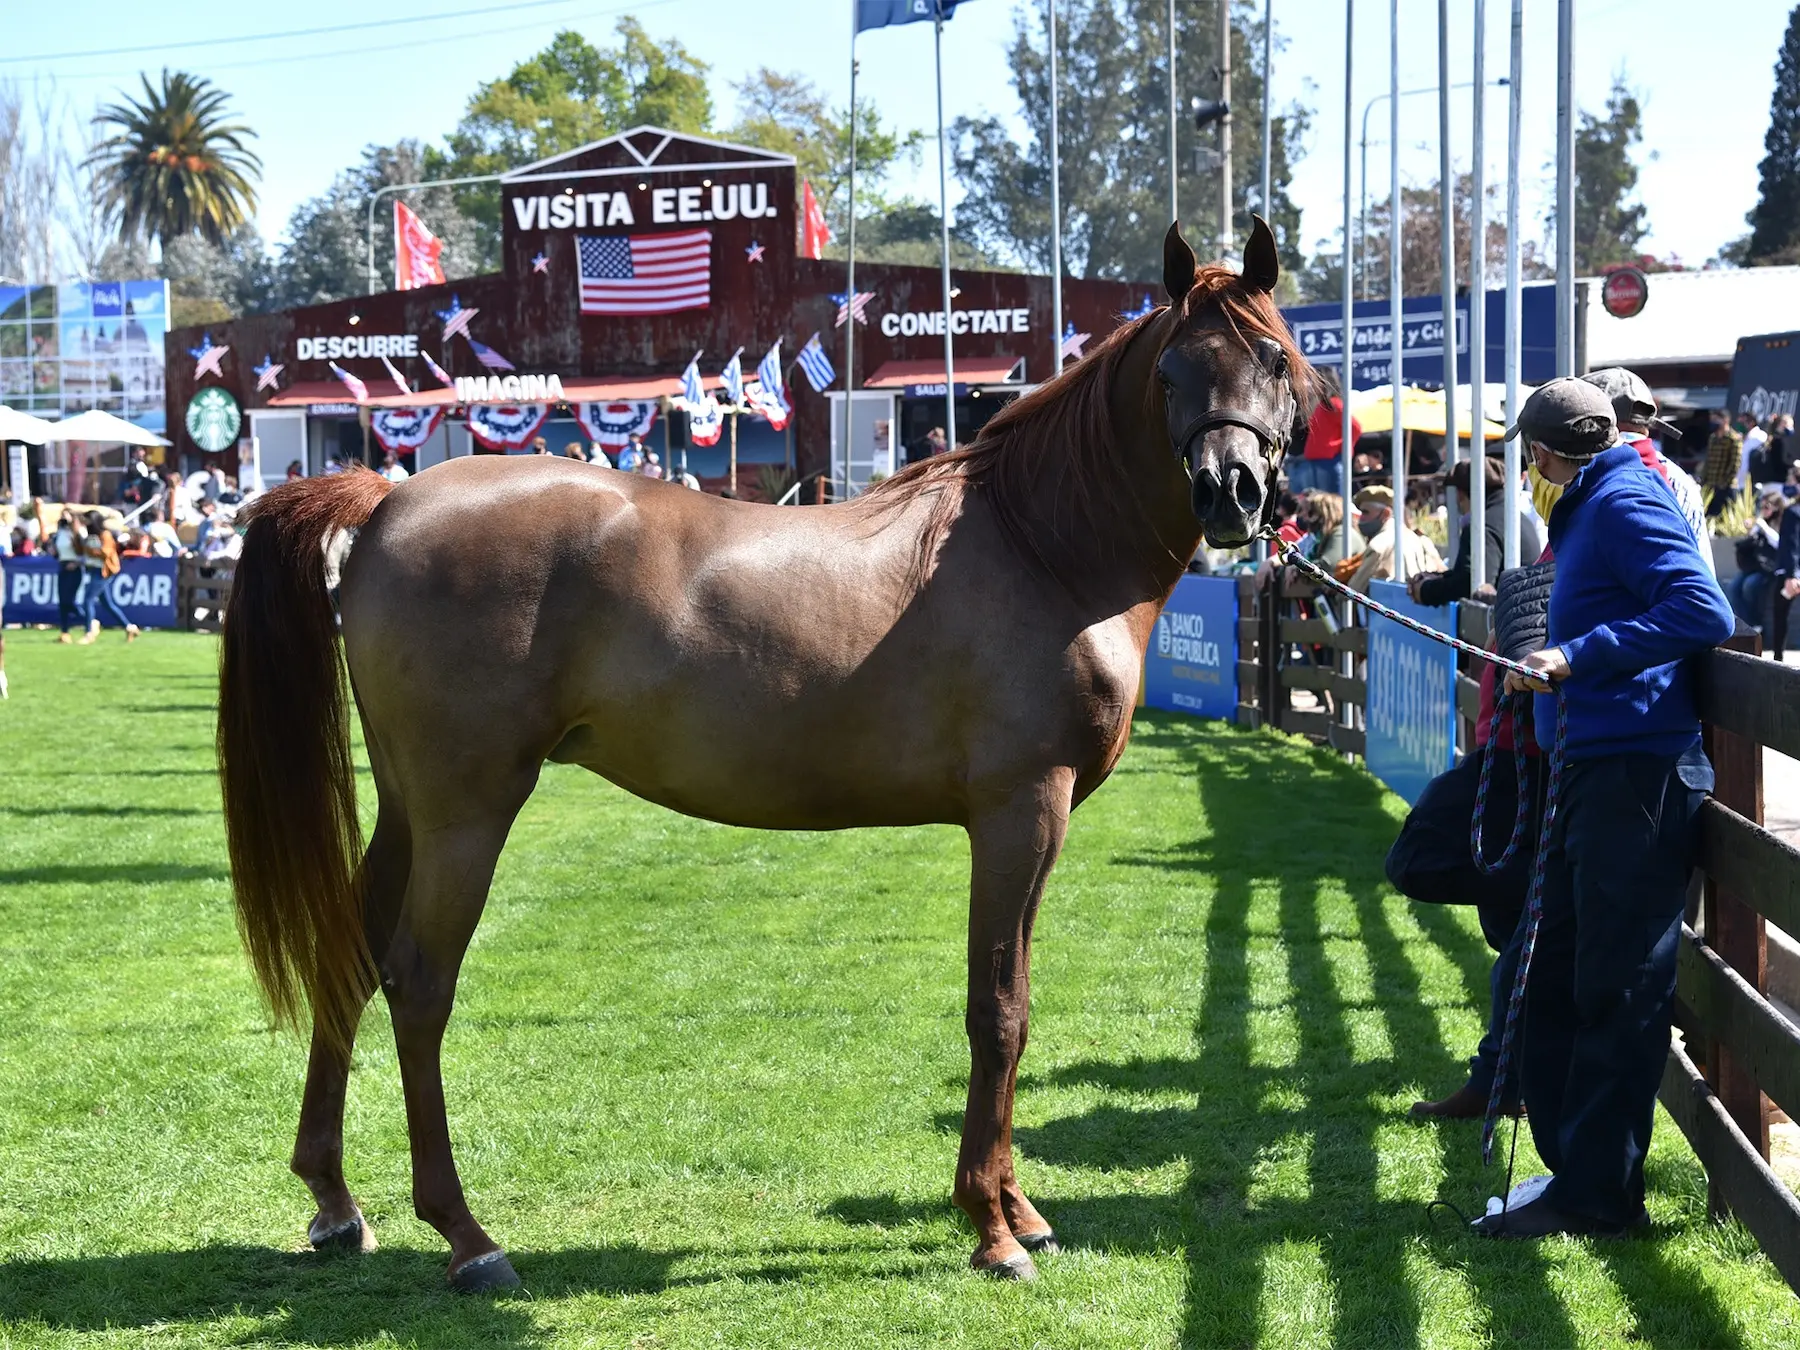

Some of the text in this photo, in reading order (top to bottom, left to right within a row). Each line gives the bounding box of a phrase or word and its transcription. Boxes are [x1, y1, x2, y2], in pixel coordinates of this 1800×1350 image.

[512, 183, 778, 231] VISITA EE.UU.
[881, 308, 1030, 337] CONECTATE
[296, 335, 419, 360] DESCUBRE
[454, 373, 566, 402] IMAGINA
[112, 573, 172, 606] CAR
[1171, 612, 1204, 639] BANCO
